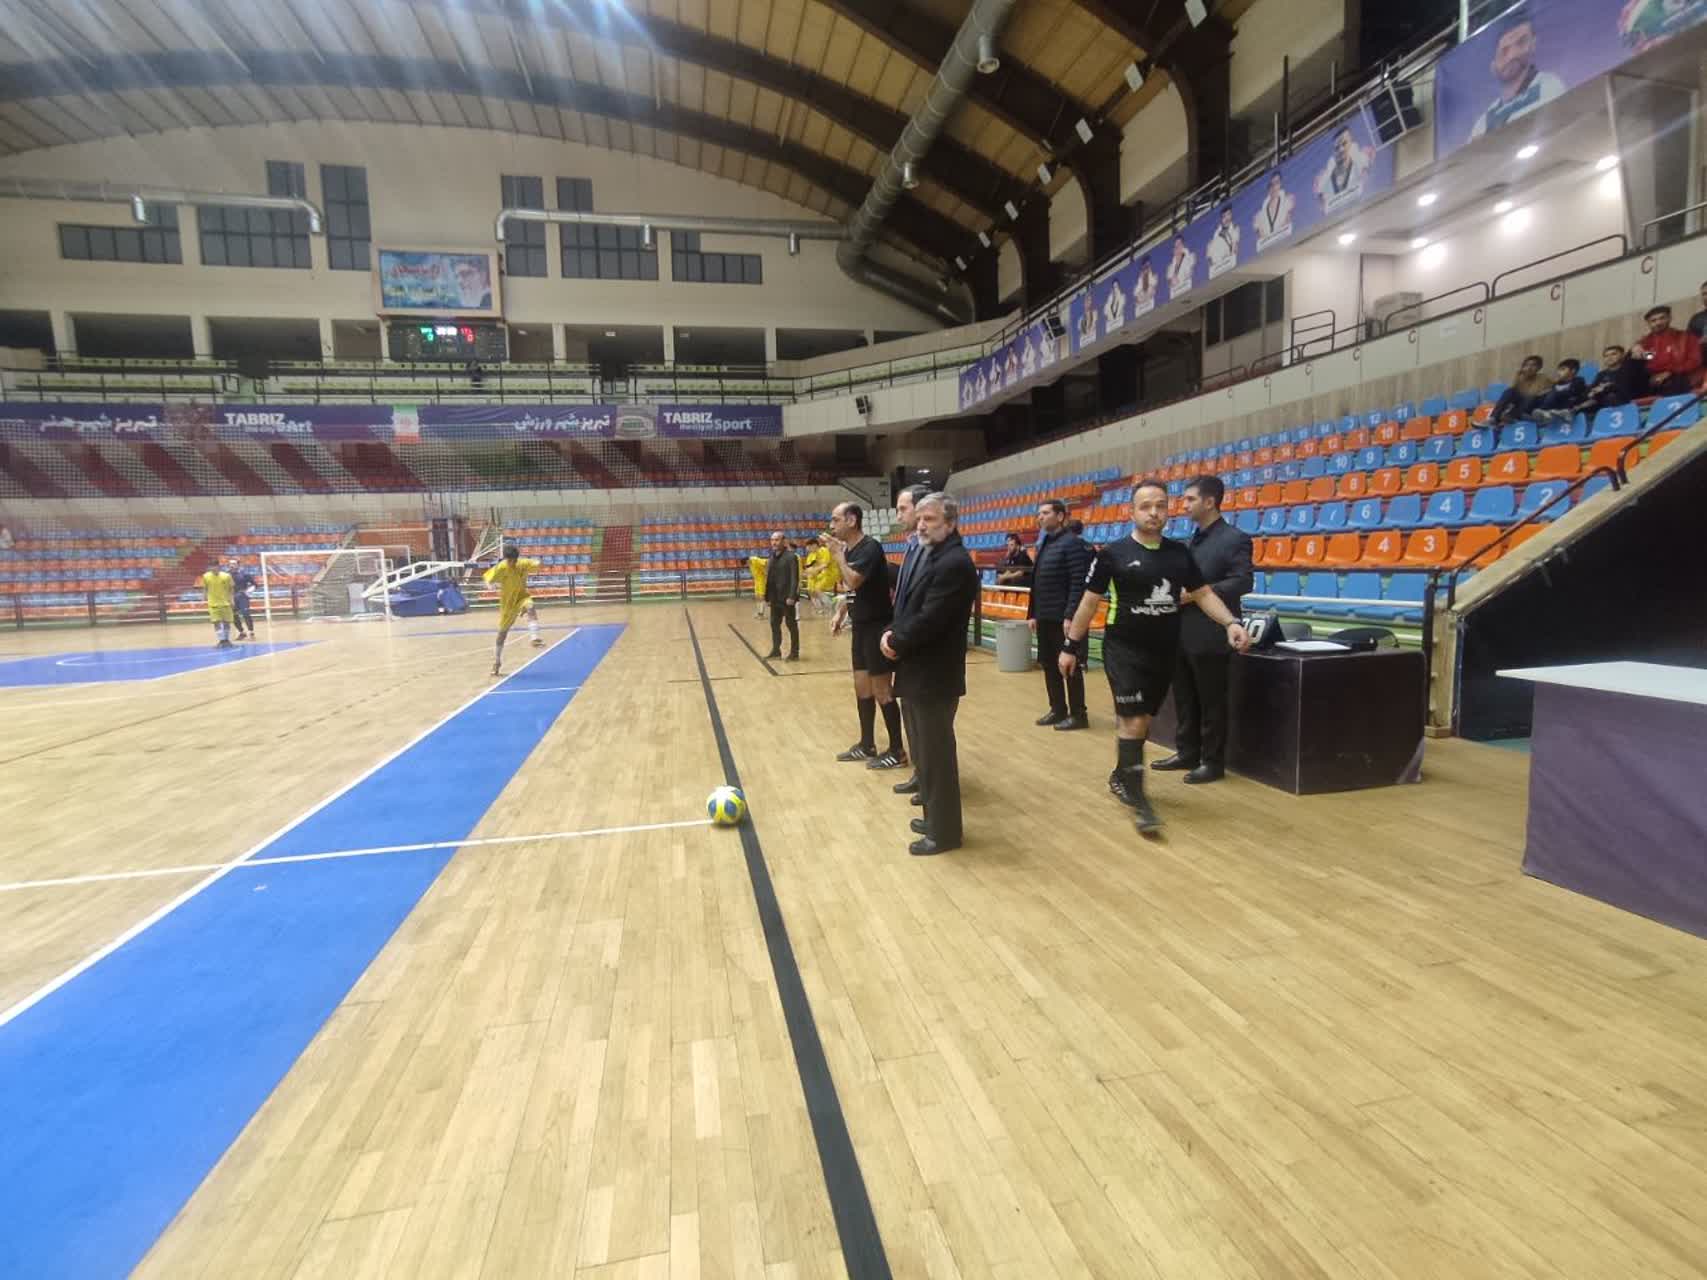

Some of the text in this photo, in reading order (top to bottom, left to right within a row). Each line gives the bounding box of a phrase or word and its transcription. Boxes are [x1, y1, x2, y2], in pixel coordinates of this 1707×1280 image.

[224, 412, 285, 425] TABRIZ
[663, 411, 713, 425] TABRIZ
[714, 419, 752, 432] Sport
[1449, 415, 1458, 428] 8
[1610, 411, 1624, 429] 3
[1471, 433, 1481, 449] 6
[1513, 426, 1525, 443] 5
[1399, 445, 1408, 460] 8
[1434, 439, 1444, 455] 7
[1460, 463, 1470, 479] 5
[1503, 457, 1515, 474] 4
[1383, 472, 1393, 487] 7
[1418, 468, 1427, 483] 6
[1361, 504, 1371, 520] 6
[1440, 498, 1451, 513] 4
[1377, 537, 1391, 553] 4
[1423, 534, 1435, 553] 3
